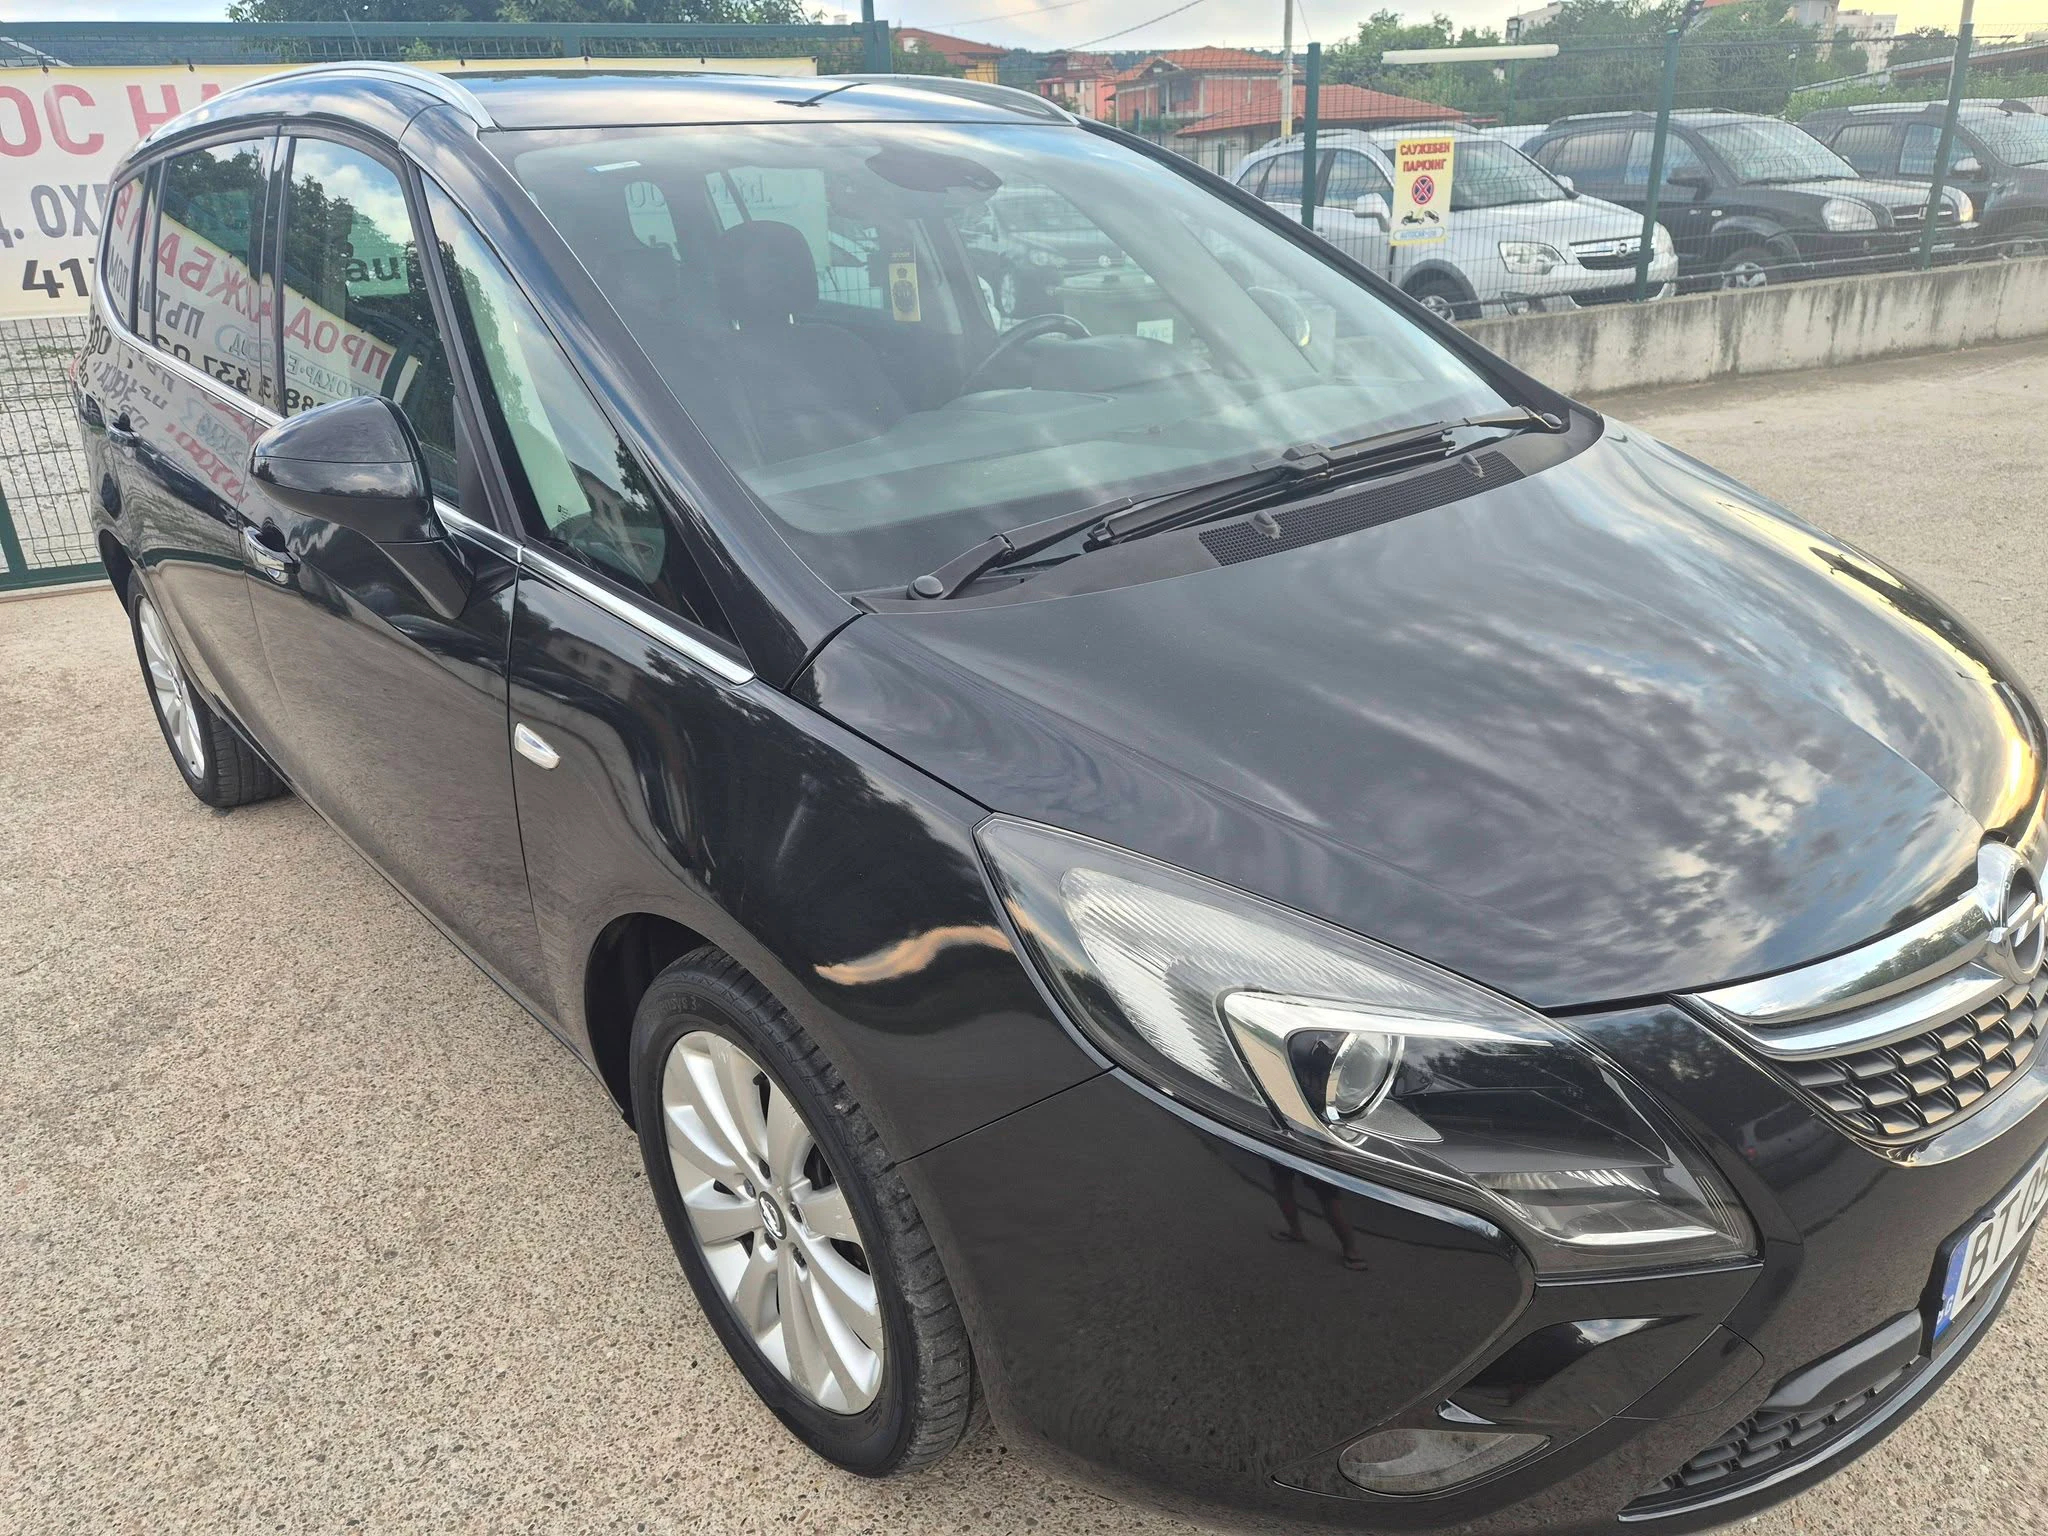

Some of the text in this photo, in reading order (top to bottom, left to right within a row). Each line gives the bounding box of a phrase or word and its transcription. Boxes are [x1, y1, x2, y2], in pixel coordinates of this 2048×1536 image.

[126, 83, 222, 140] Н
[1400, 142, 1450, 156] СЛУЖЕБЕН
[1403, 159, 1447, 172] ПАРКИНГ
[22, 257, 95, 298] 41
[1962, 1189, 2021, 1300] BT
